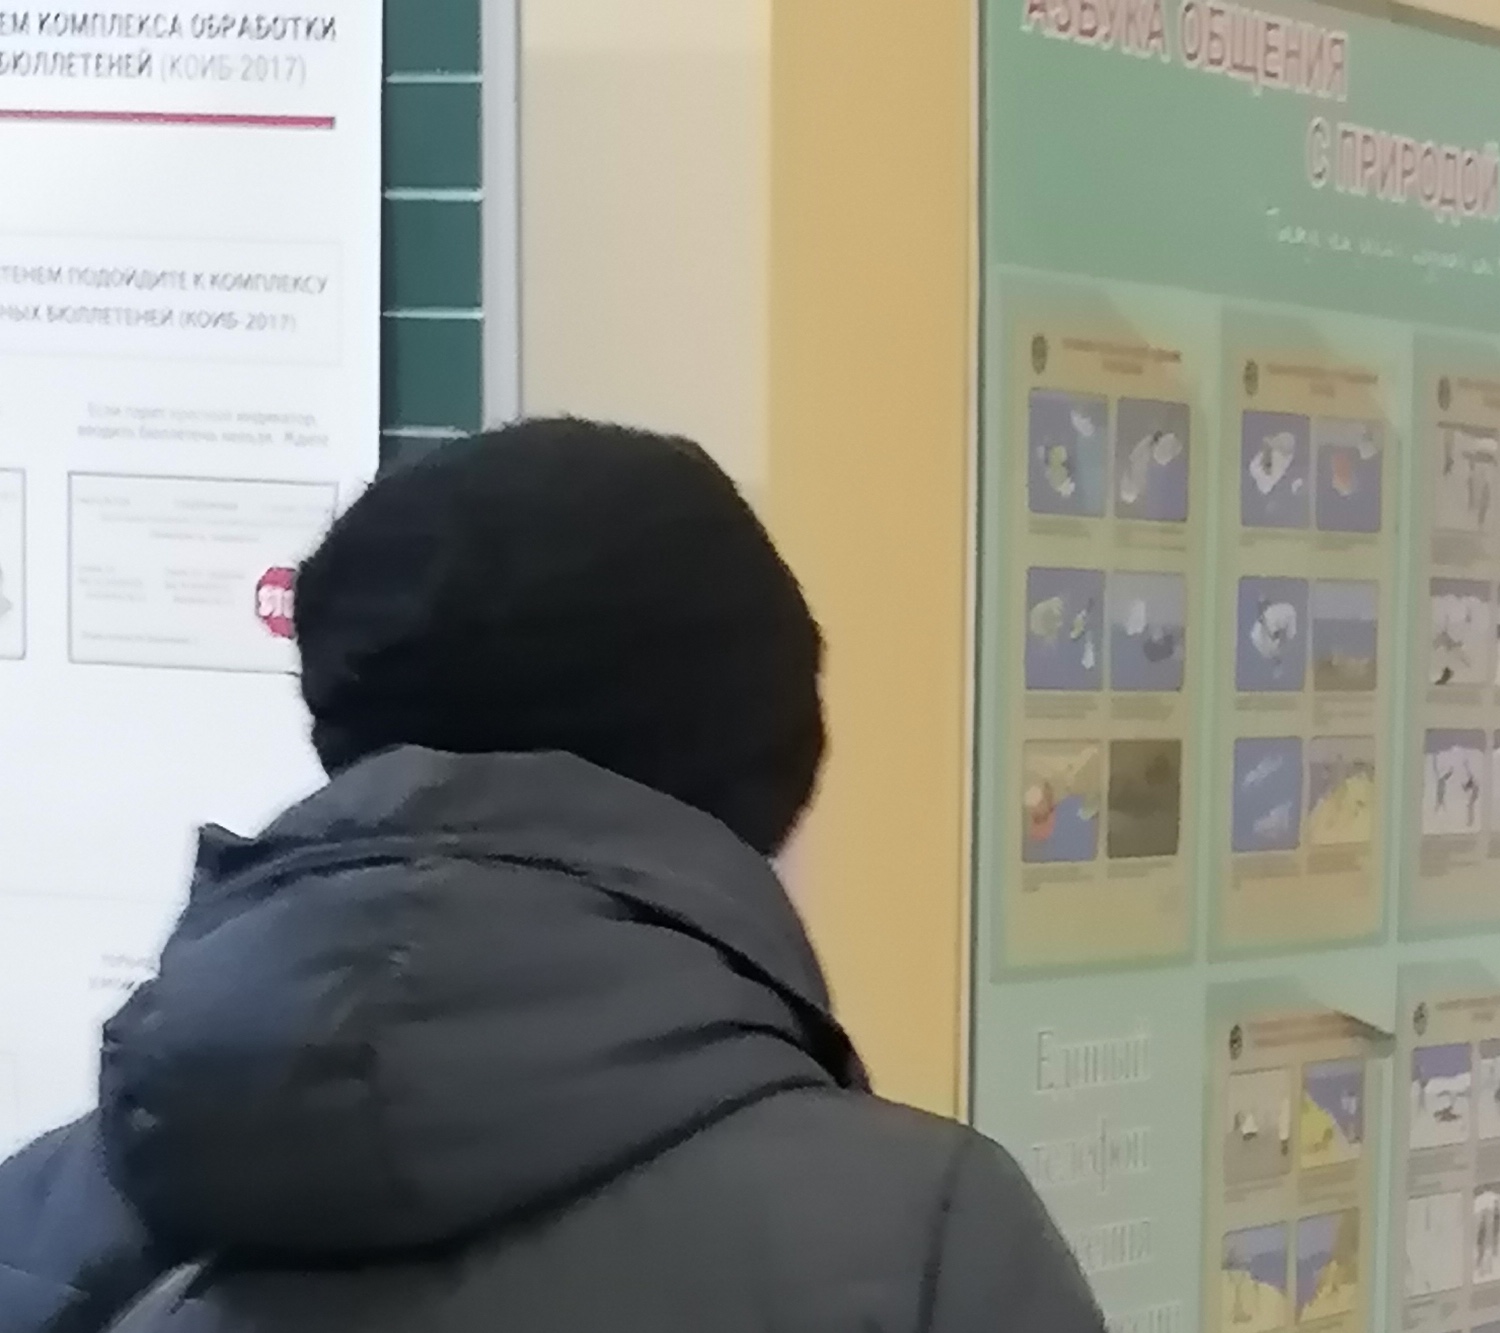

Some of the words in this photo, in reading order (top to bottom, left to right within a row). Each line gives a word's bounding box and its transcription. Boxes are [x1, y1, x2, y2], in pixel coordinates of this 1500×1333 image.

[38, 12, 183, 39] КОМПЛЕКСА
[190, 13, 337, 41] ОБРАБОТКИ
[1178, 0, 1347, 101] ОБЩЕНИЯ
[1306, 116, 1332, 189] С
[67, 267, 188, 291] ПОДОЙДИТЕ
[192, 272, 206, 291] К
[209, 272, 328, 294] КОМПЛЕКСУ
[46, 304, 175, 328] БЮЛЛЕТЕНЕЙ
